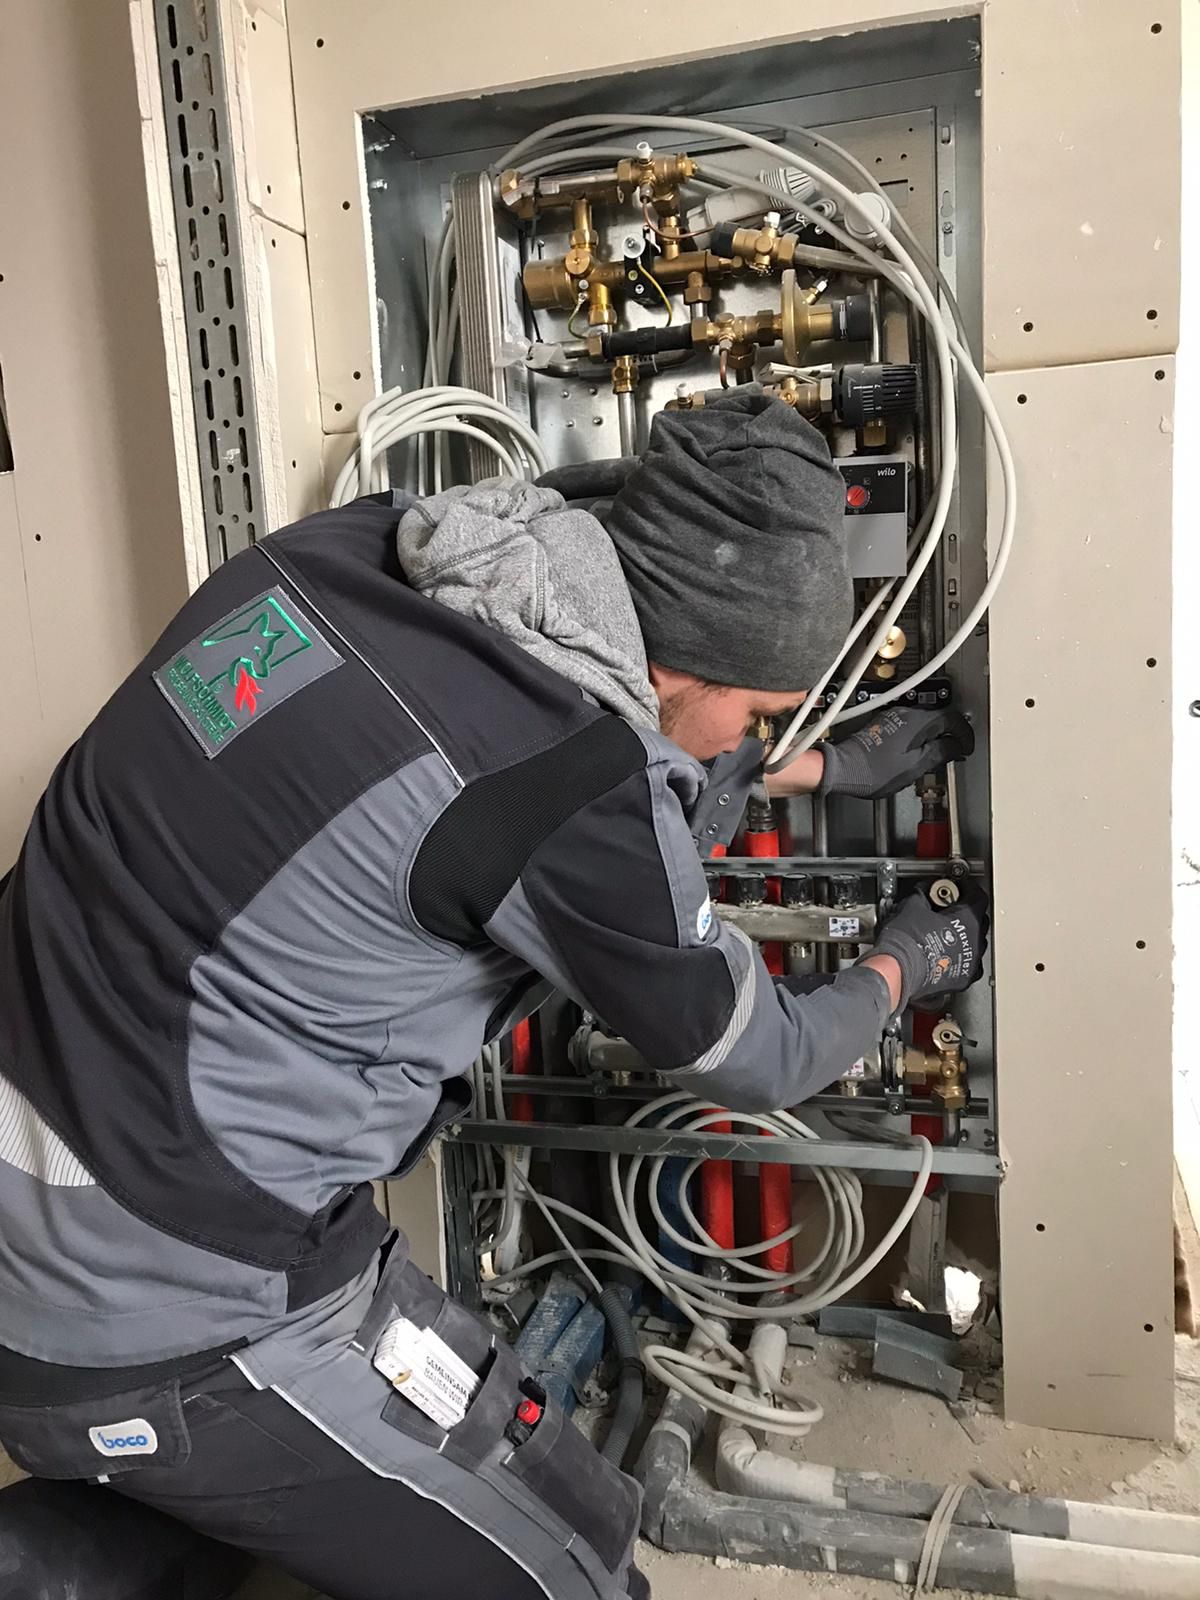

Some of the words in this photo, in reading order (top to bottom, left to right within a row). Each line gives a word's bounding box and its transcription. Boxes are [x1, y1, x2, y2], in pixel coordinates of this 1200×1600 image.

[877, 467, 896, 476] wilo
[950, 918, 973, 977] MaxiFlex
[97, 1431, 148, 1449] boco
